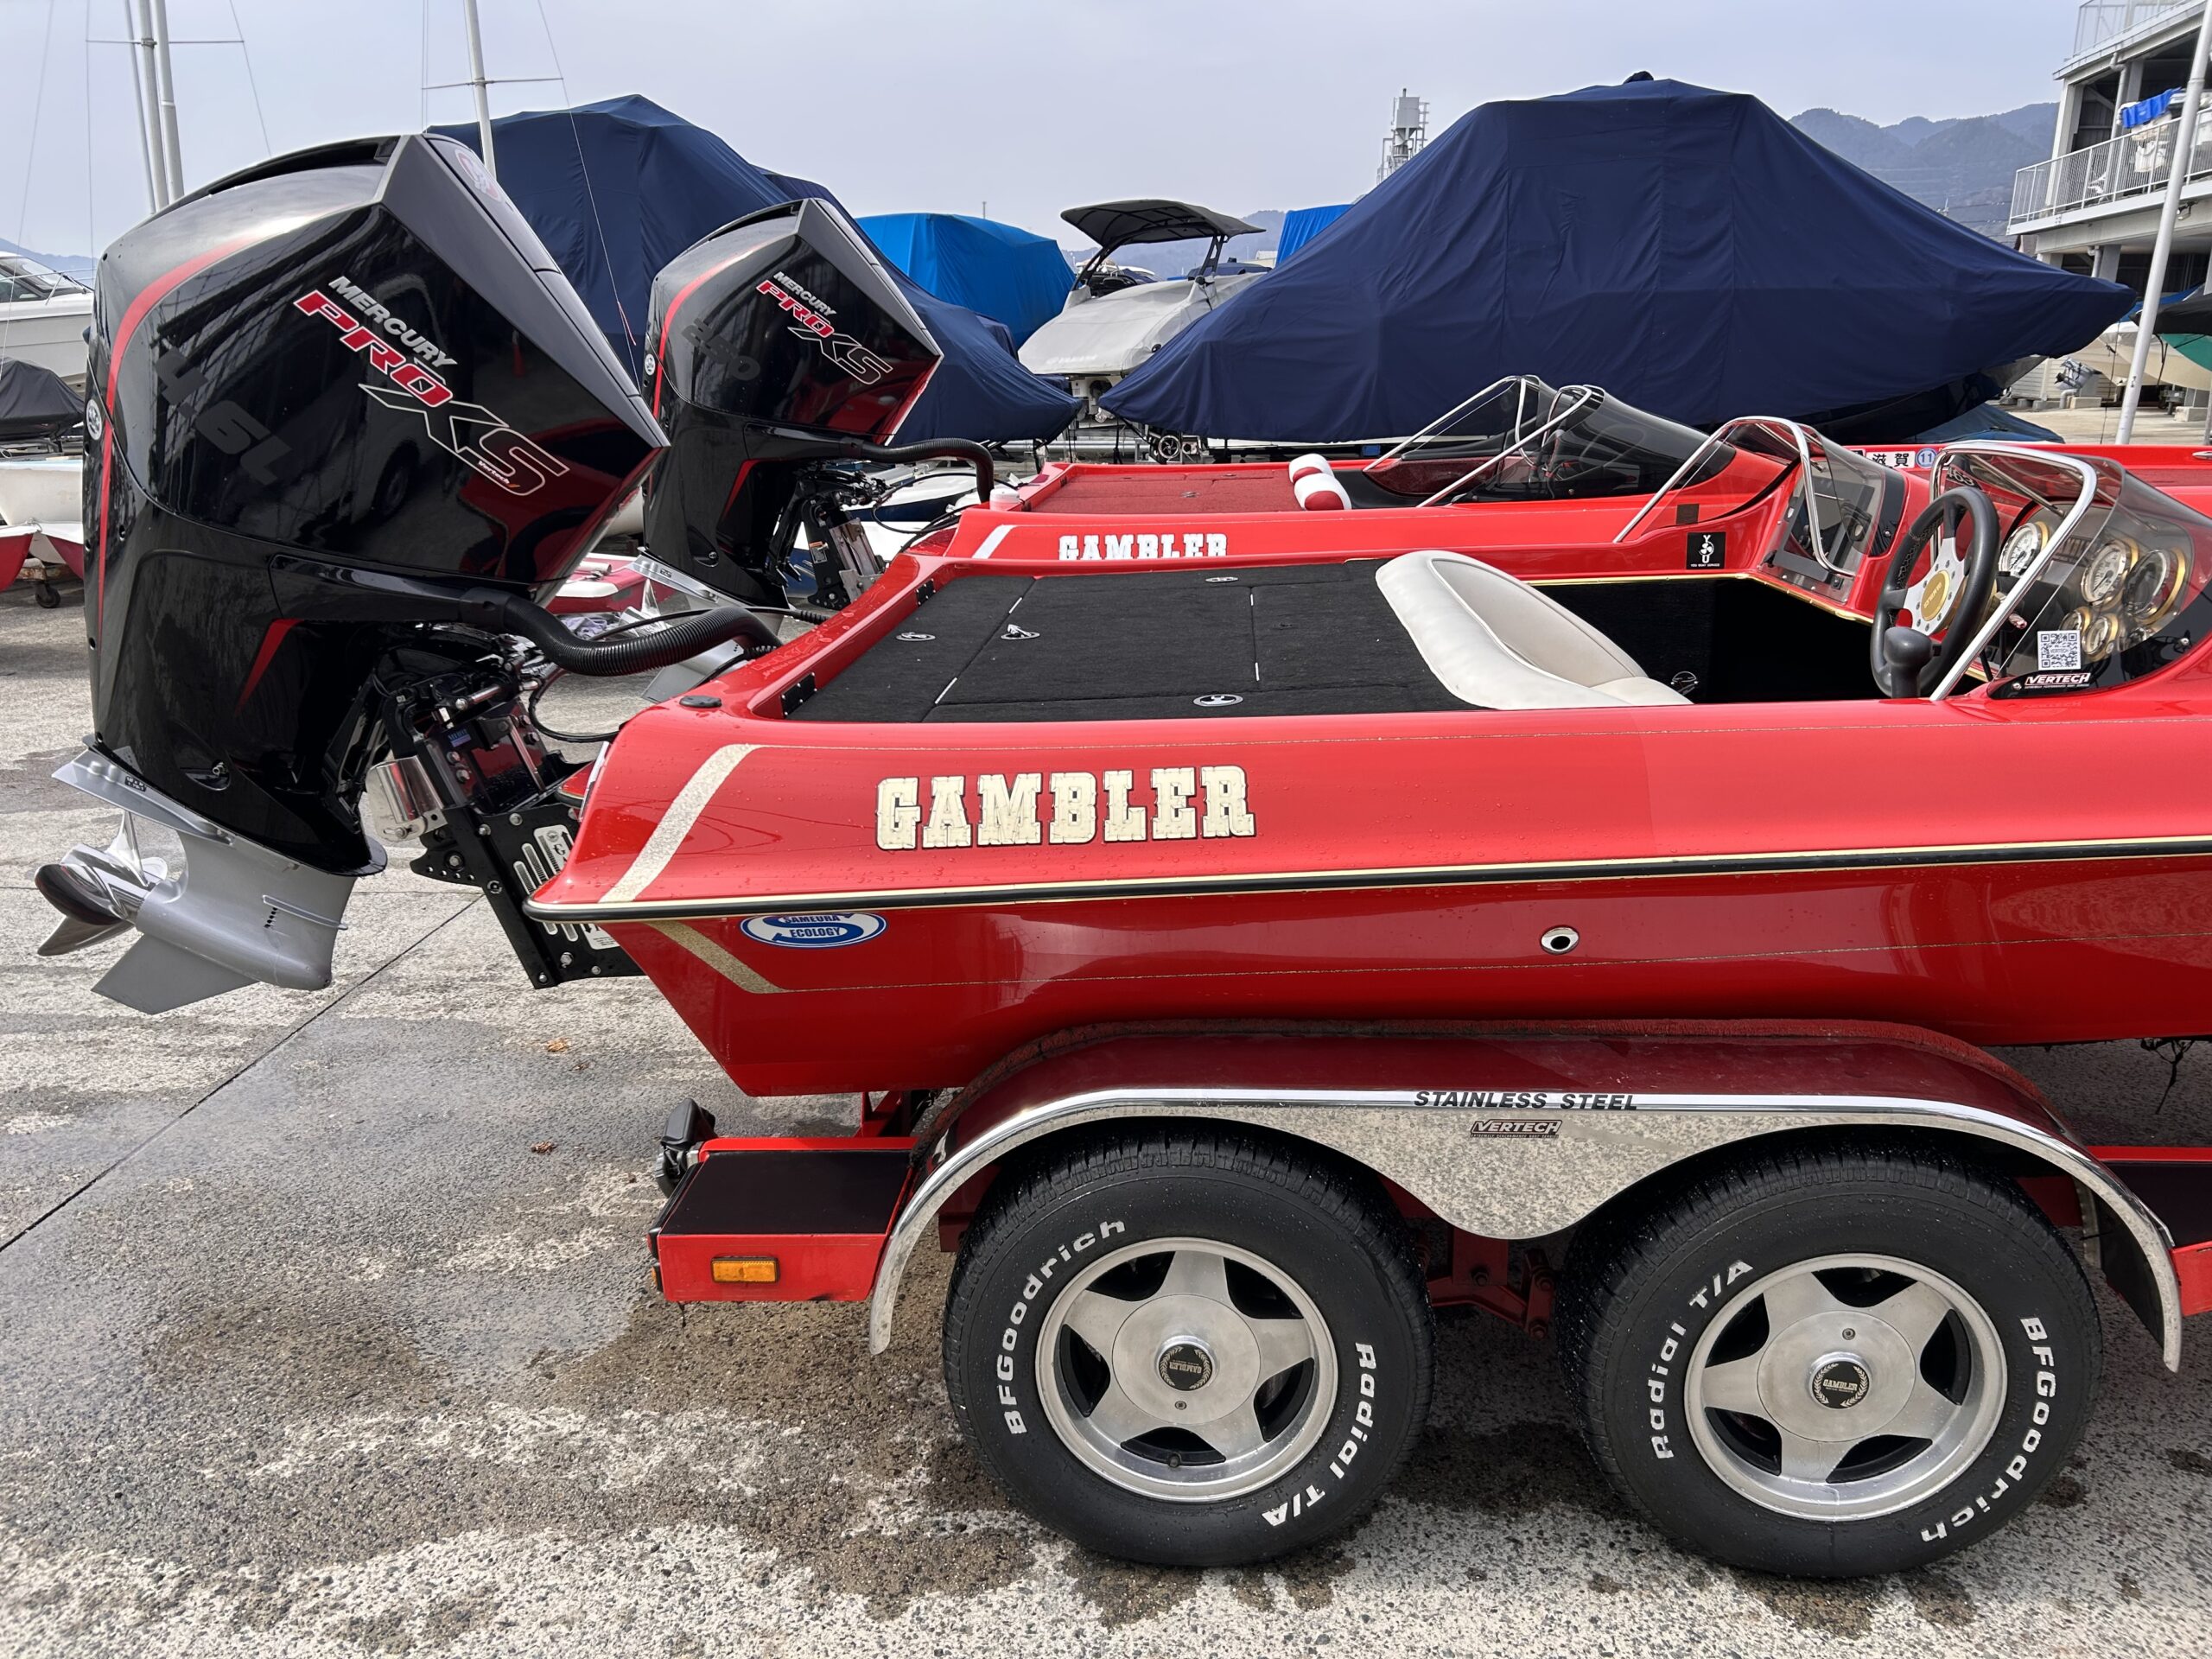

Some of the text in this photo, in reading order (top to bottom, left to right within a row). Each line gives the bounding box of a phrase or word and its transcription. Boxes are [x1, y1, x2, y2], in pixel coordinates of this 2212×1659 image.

[756, 279, 835, 338] PRO
[773, 271, 837, 317] MERCURY
[328, 276, 458, 368] MERCURY
[787, 311, 894, 385] XS
[293, 289, 454, 408] PRO
[154, 346, 292, 486] 4.6L
[358, 357, 571, 496] XS
[1872, 453, 1910, 467] 滋賀
[1920, 452, 1934, 463] 11
[1058, 533, 1228, 561] GAMBLER
[2024, 672, 2091, 686] VERTECH
[874, 765, 1256, 851] GAMBLER
[785, 914, 841, 924] SAMEURA
[789, 927, 841, 938] ECOLOGY
[1414, 1090, 1637, 1110] STAINLESS STEEL
[1471, 1119, 1562, 1134] VERTECH
[996, 1219, 1126, 1434] BFGoodrich
[1169, 1361, 1202, 1374] GAMBLER
[1648, 1260, 1754, 1459] Radial T/A
[1822, 1379, 1858, 1391] GAMBLER
[1262, 1342, 1376, 1527] Radial T/A
[1920, 1317, 2056, 1542] BFGoodrich
